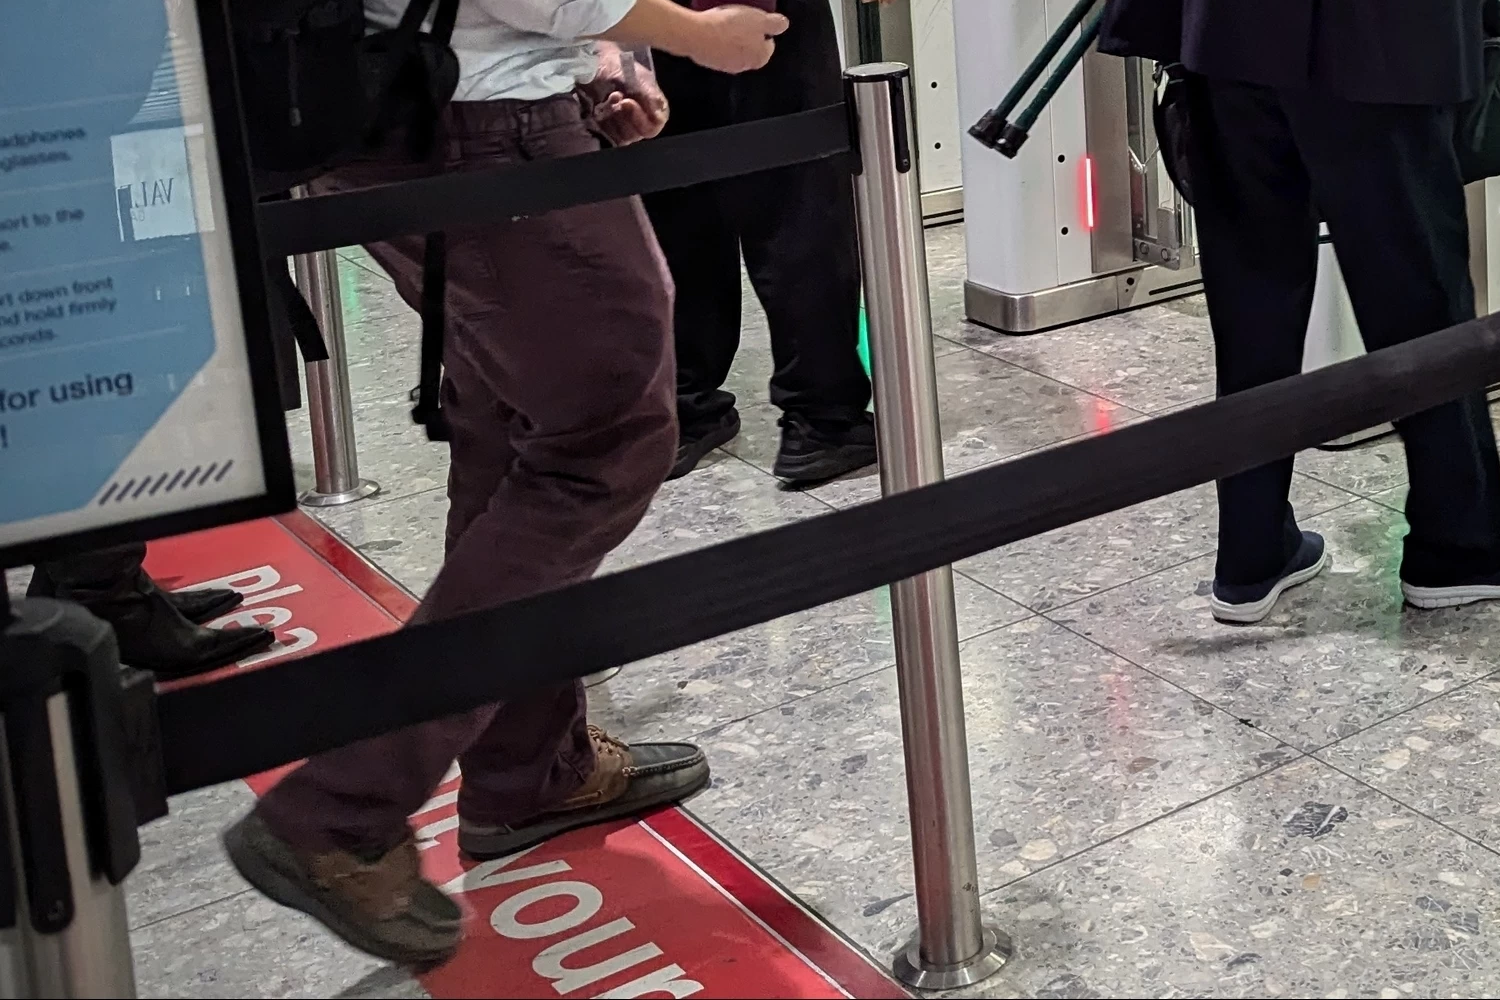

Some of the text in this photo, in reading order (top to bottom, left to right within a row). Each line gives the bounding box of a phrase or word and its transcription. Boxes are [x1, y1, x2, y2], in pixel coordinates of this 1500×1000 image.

[18, 284, 68, 303] down
[24, 303, 64, 322] hold
[50, 371, 134, 404] using
